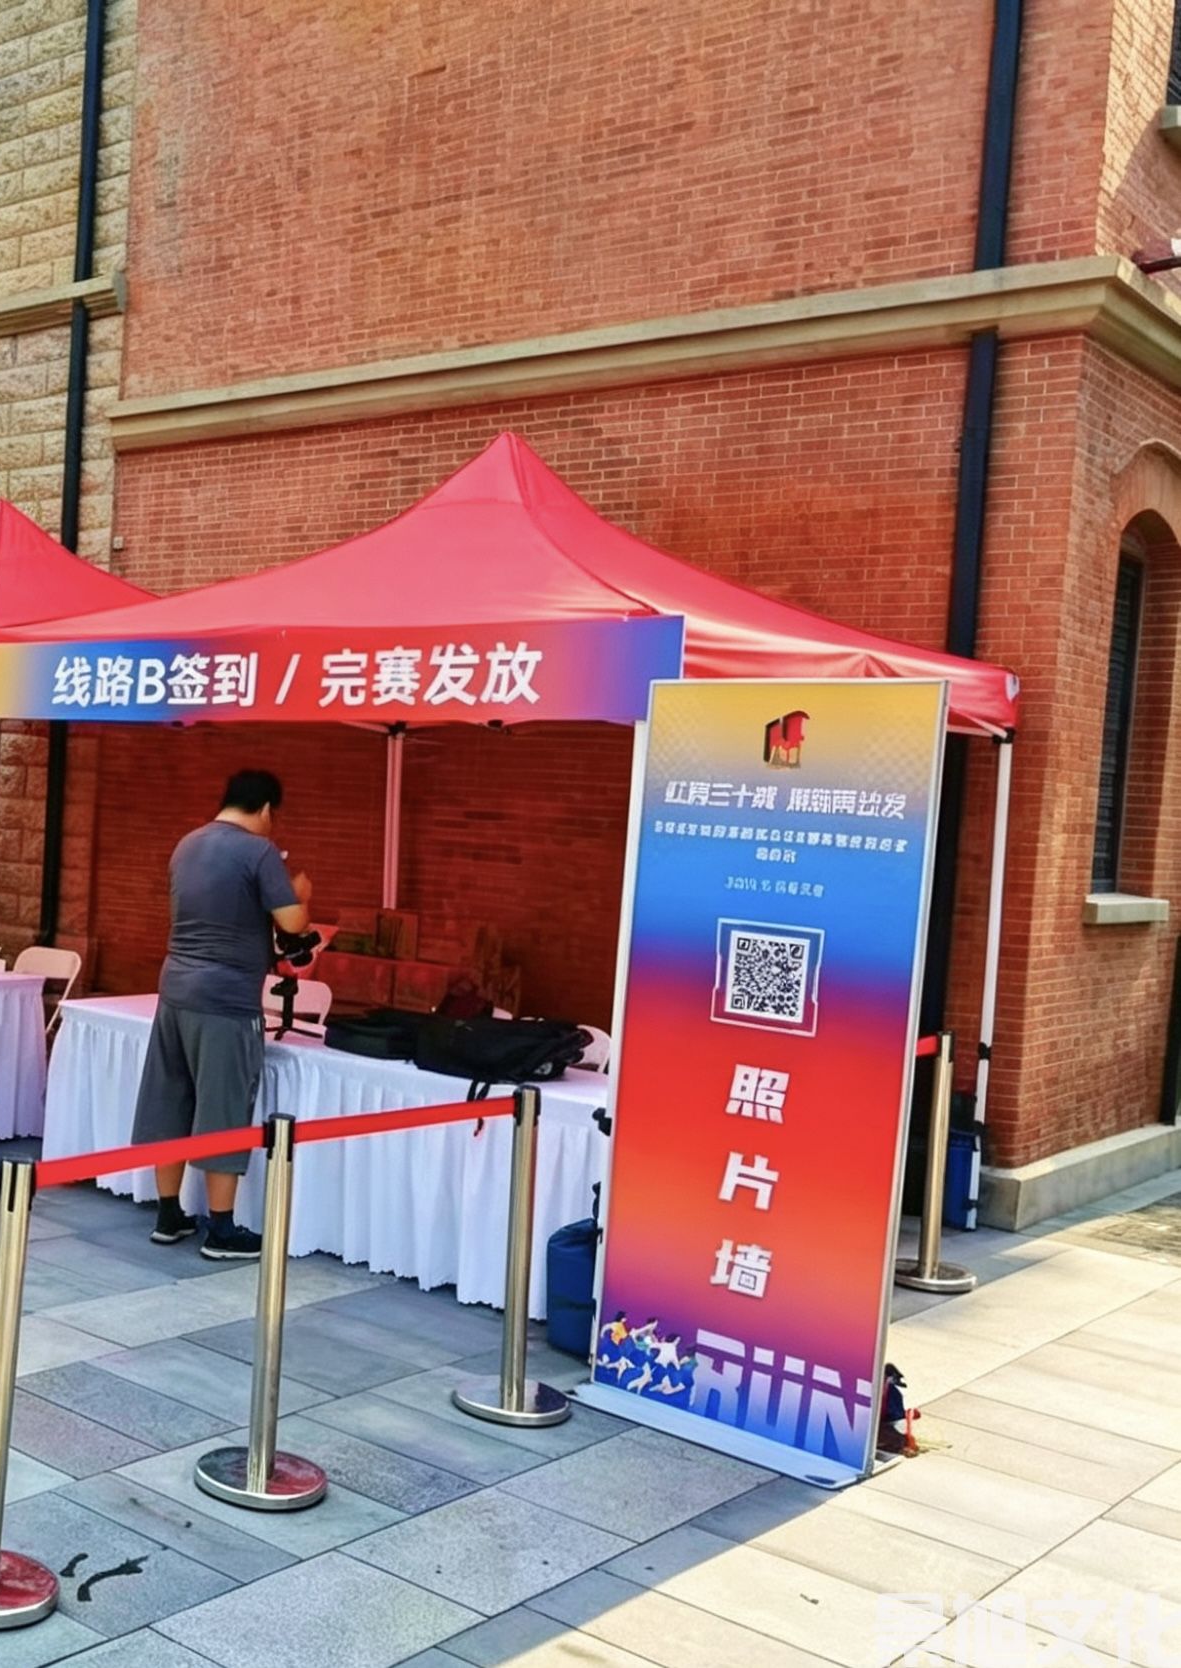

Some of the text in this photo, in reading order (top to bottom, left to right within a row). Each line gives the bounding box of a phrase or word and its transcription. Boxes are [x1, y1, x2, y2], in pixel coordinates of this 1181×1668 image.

[52, 641, 543, 707] 线路B签到 / 完赛发放
[709, 1063, 790, 1298] 照片墙
